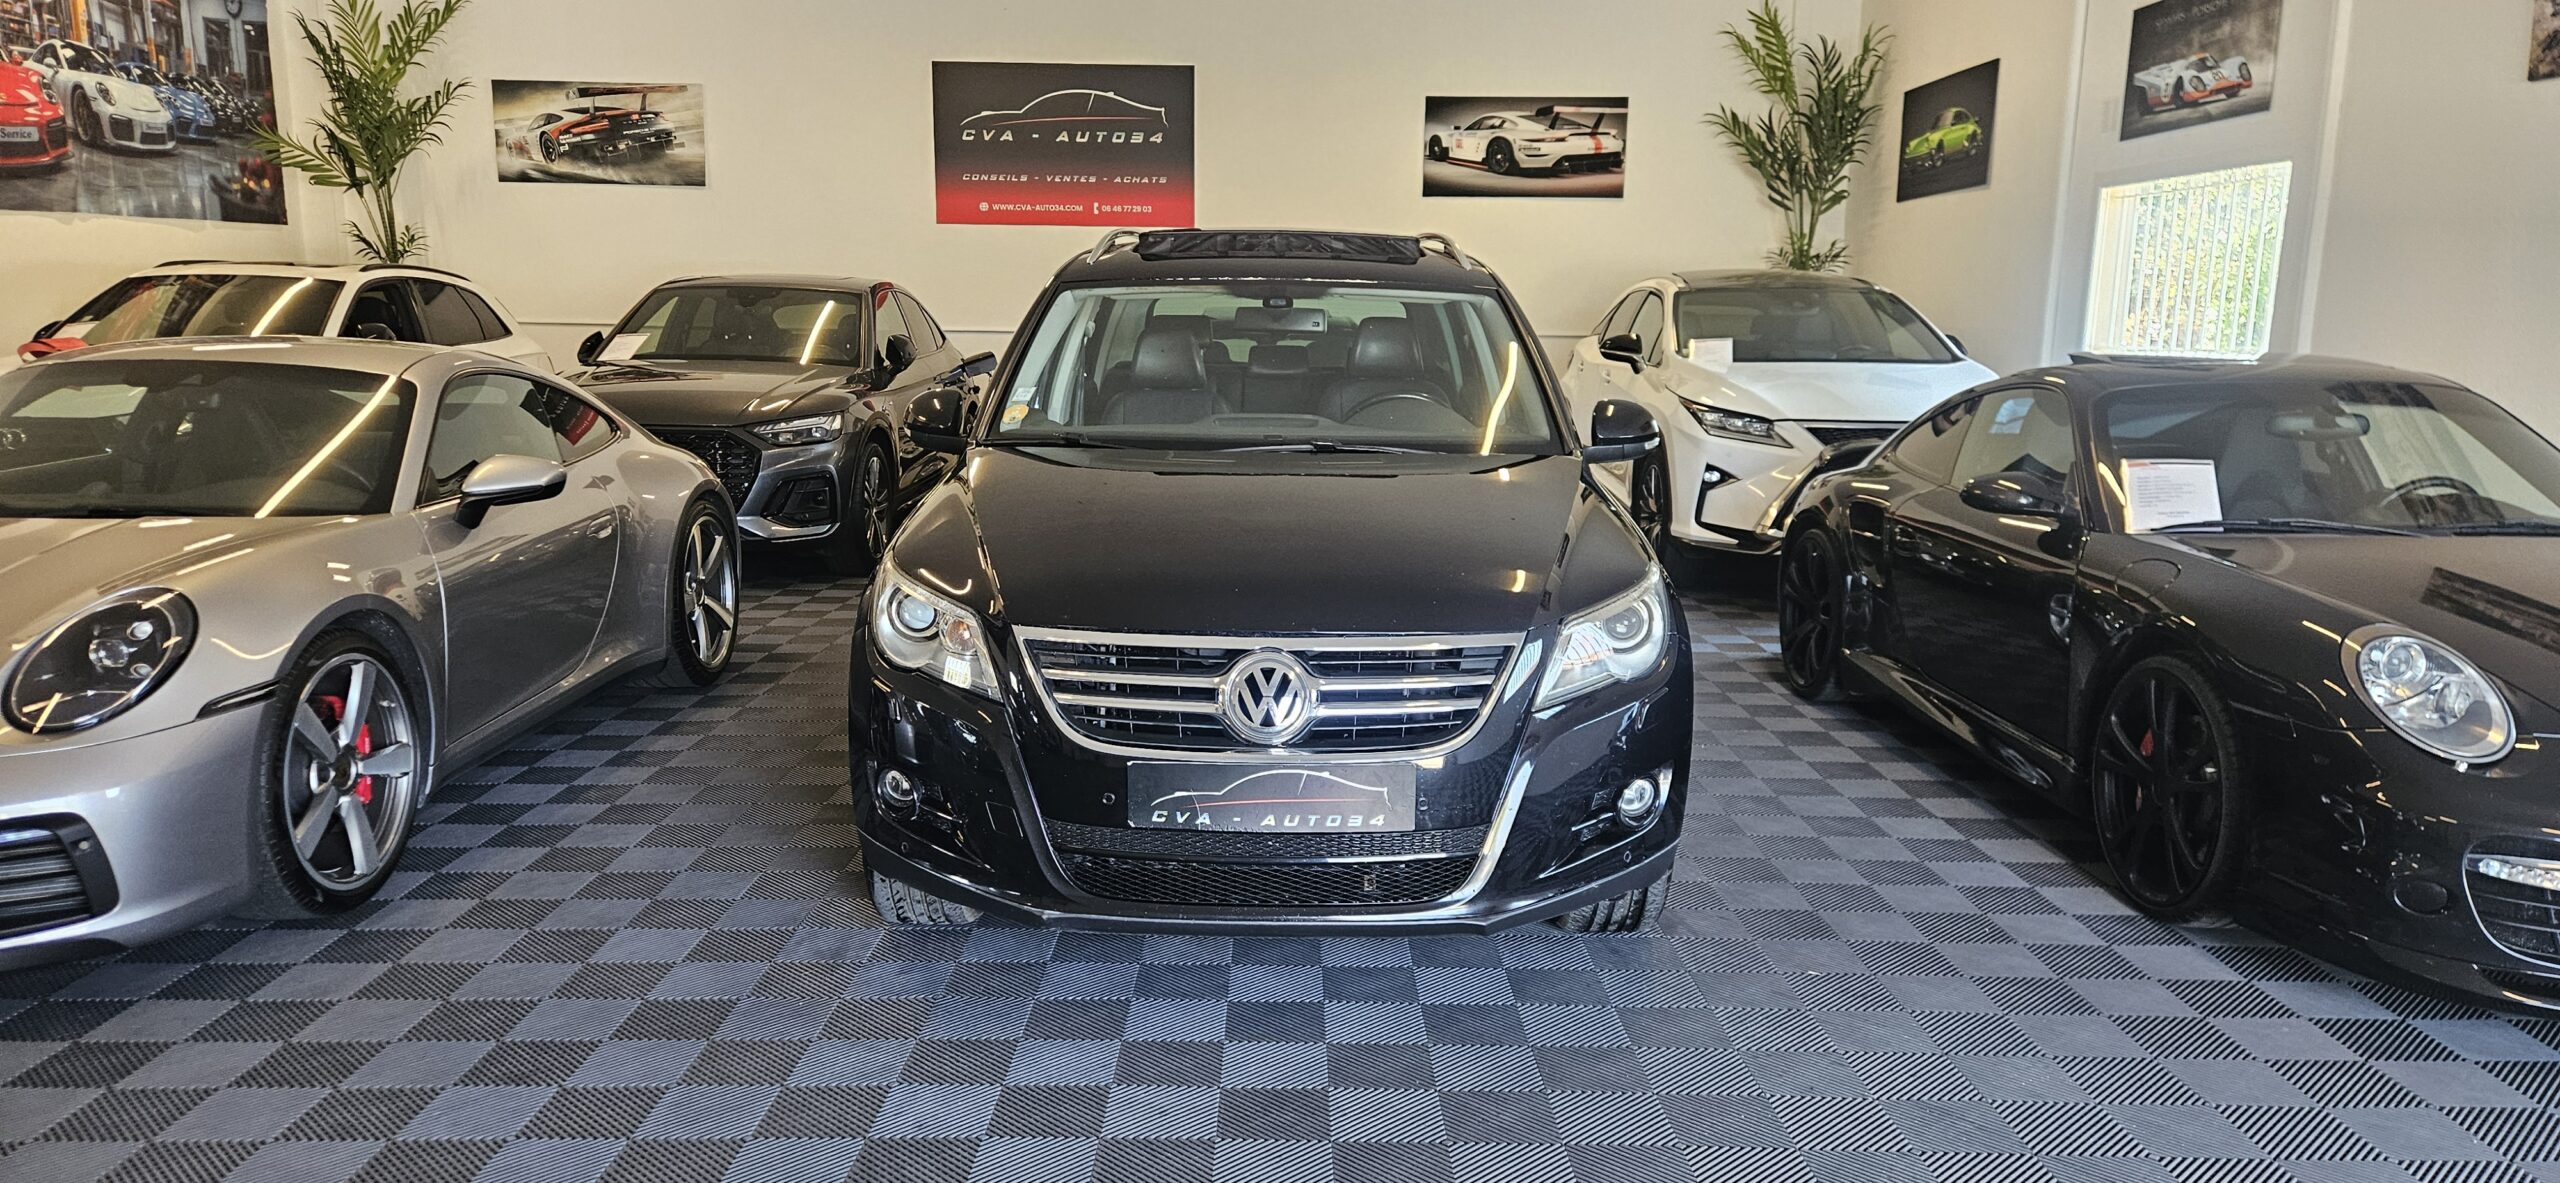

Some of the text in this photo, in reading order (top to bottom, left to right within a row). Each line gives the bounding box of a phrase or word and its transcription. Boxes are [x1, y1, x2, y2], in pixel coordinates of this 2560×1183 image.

[961, 129, 1014, 141] CVA
[1055, 131, 1164, 144] AUTO34
[962, 173, 1028, 182] CONSEILS
[1046, 174, 1097, 183] VENTES
[1113, 175, 1168, 184] ACHATS
[992, 203, 1083, 212] WWW.CVA-AUTO34.COM
[1142, 205, 1152, 213] 03
[1152, 810, 1211, 825] CVA
[1260, 814, 1386, 827] AUTO34
